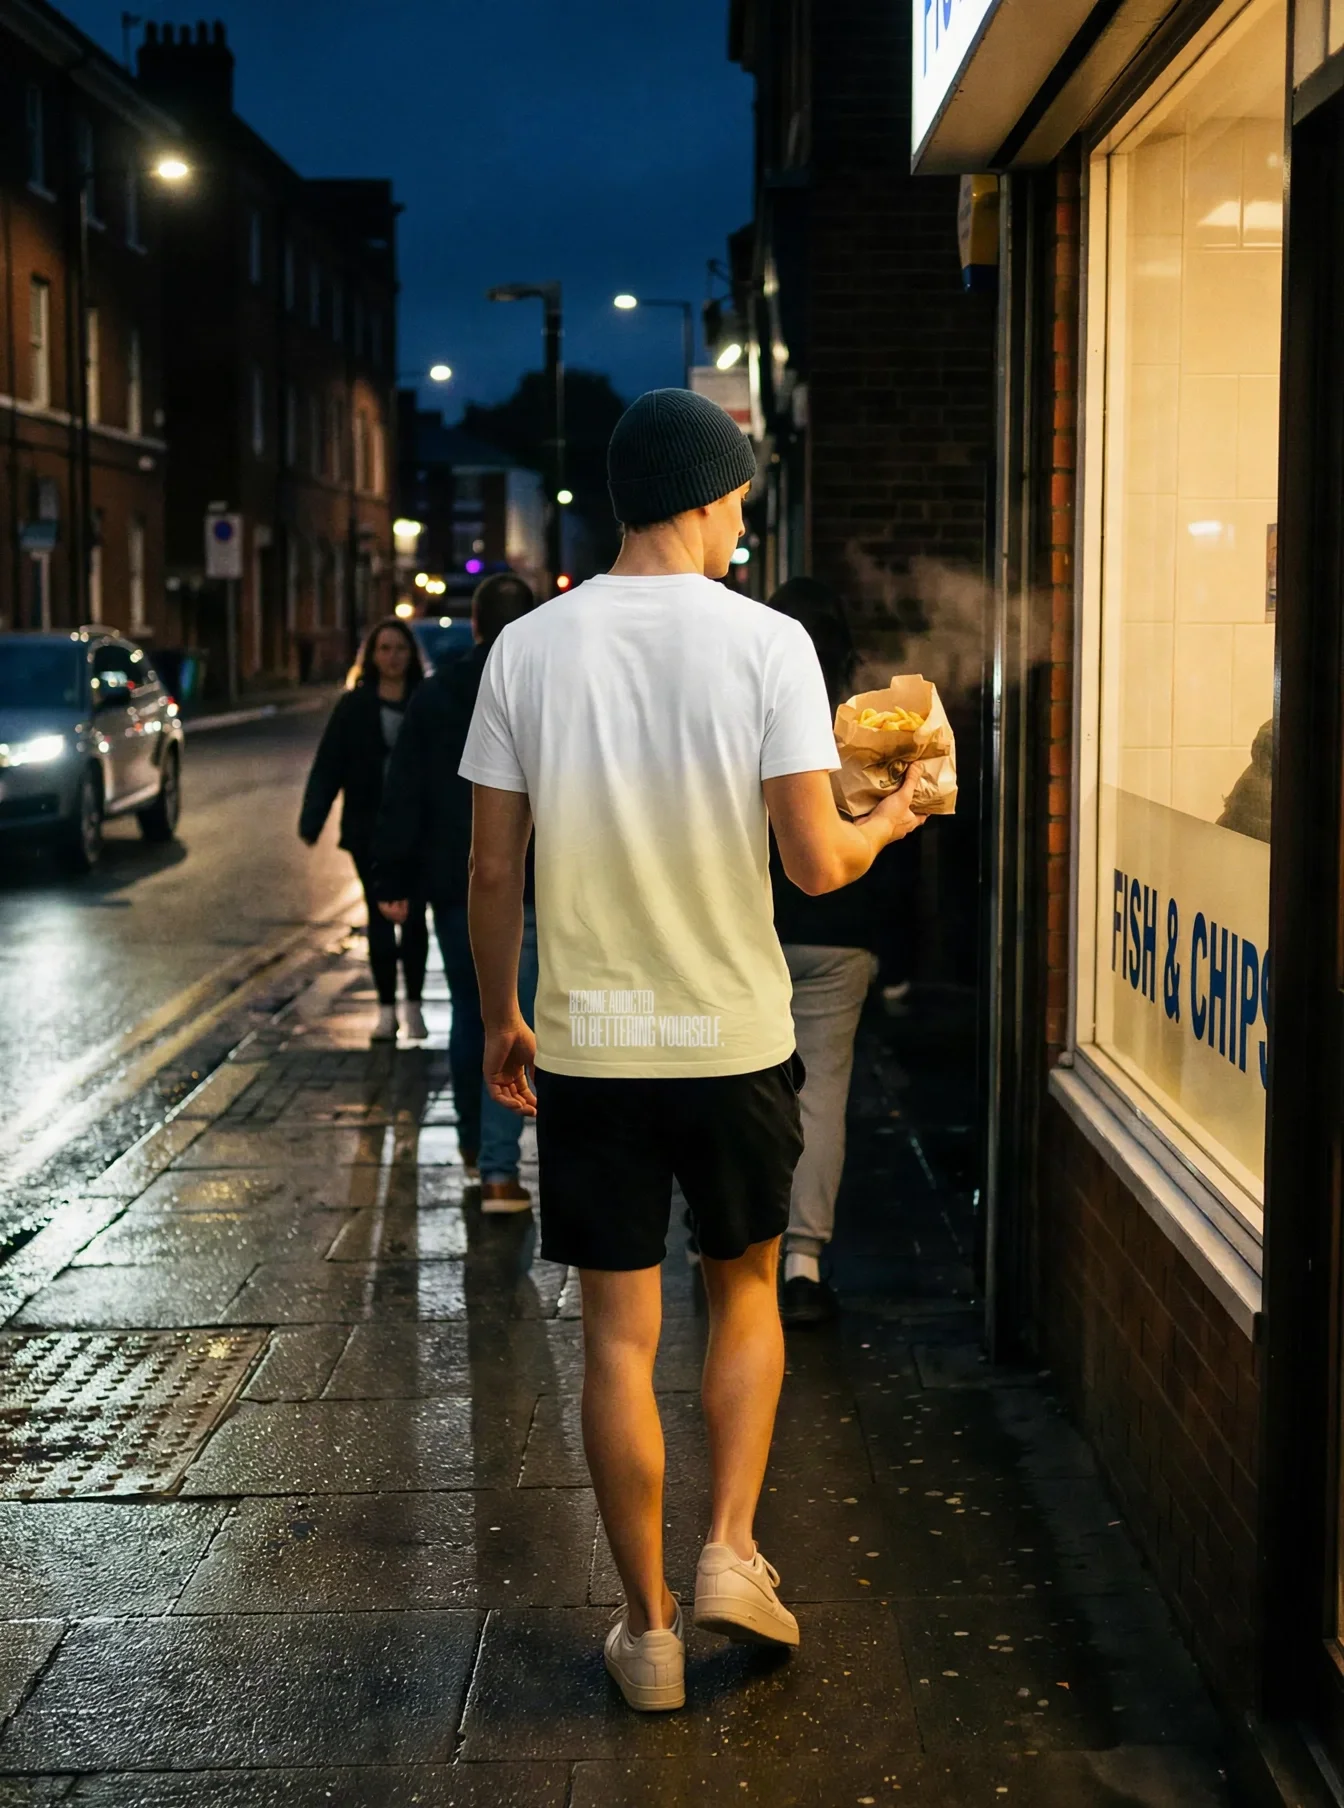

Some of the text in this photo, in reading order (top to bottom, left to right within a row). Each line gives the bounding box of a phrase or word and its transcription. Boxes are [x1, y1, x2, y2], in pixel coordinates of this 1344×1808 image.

[1112, 868, 1157, 1003] FISH
[1164, 898, 1180, 1024] &
[569, 989, 654, 1014] BECOME ADDICTED
[569, 1015, 725, 1047] TO BETTERING YOURSELF.
